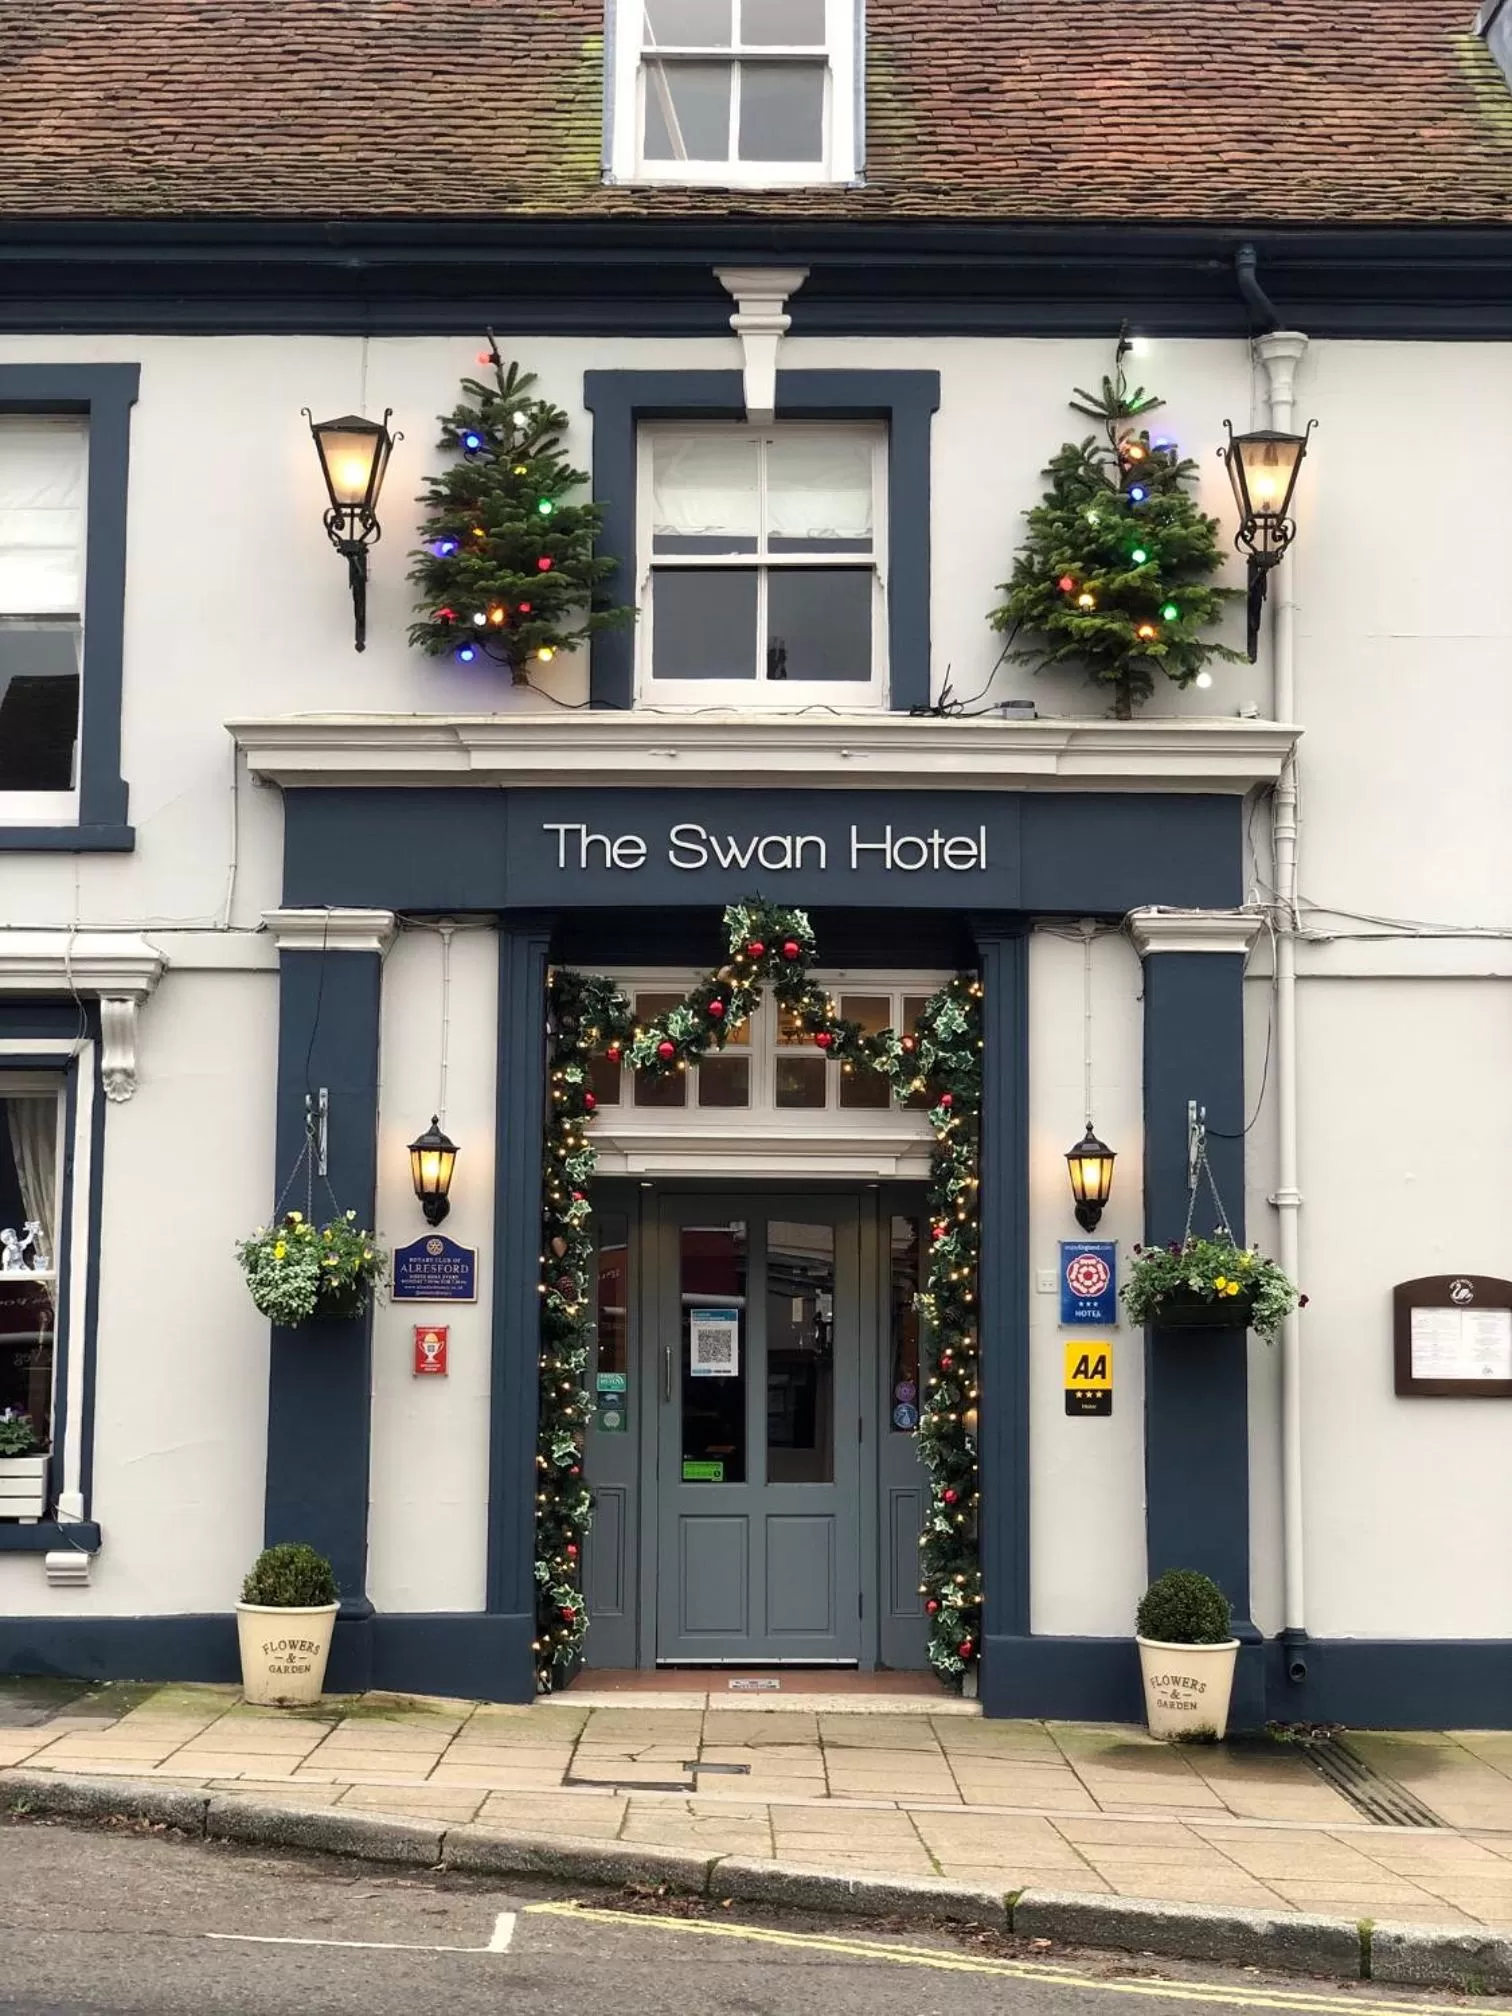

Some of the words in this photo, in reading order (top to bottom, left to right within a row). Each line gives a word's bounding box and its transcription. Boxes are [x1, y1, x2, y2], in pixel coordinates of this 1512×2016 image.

[543, 824, 647, 870] The
[668, 823, 826, 870] Swan
[850, 824, 986, 870] Hotel
[400, 1264, 469, 1274] ALRESFORD
[1075, 1310, 1101, 1318] HOTEL
[1072, 1354, 1107, 1380] AA
[262, 1639, 320, 1655] FLOWERS
[286, 1652, 297, 1663] &
[268, 1664, 311, 1674] GARDEN
[1150, 1674, 1207, 1694] FLOWERS
[1169, 1688, 1181, 1700] &
[1156, 1699, 1198, 1711] GARDEN
